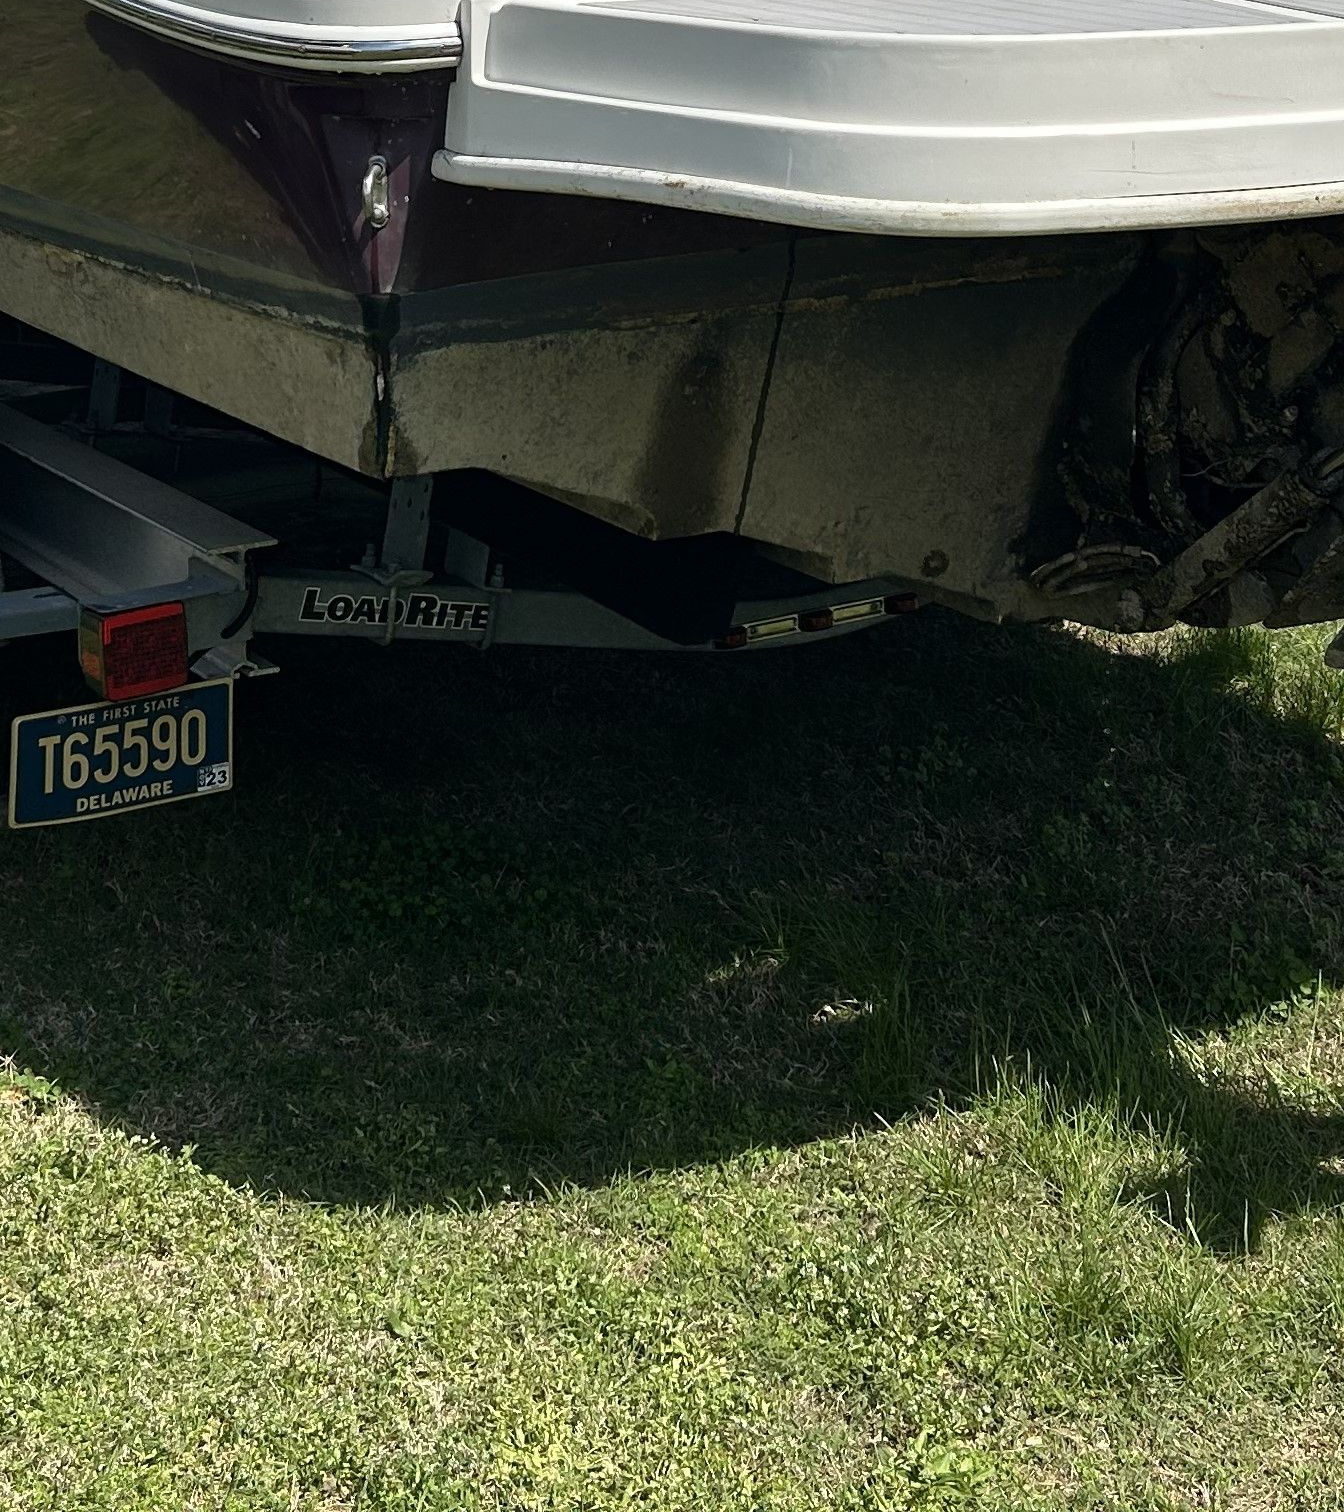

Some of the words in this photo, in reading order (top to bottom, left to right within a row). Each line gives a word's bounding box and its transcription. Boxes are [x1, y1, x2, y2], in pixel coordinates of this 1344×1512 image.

[71, 713, 96, 728] THE
[103, 704, 137, 721] FIRST
[143, 696, 181, 714] STATE
[38, 708, 207, 795] T65590
[206, 769, 228, 786] 23
[76, 779, 174, 814] DELAWARE
